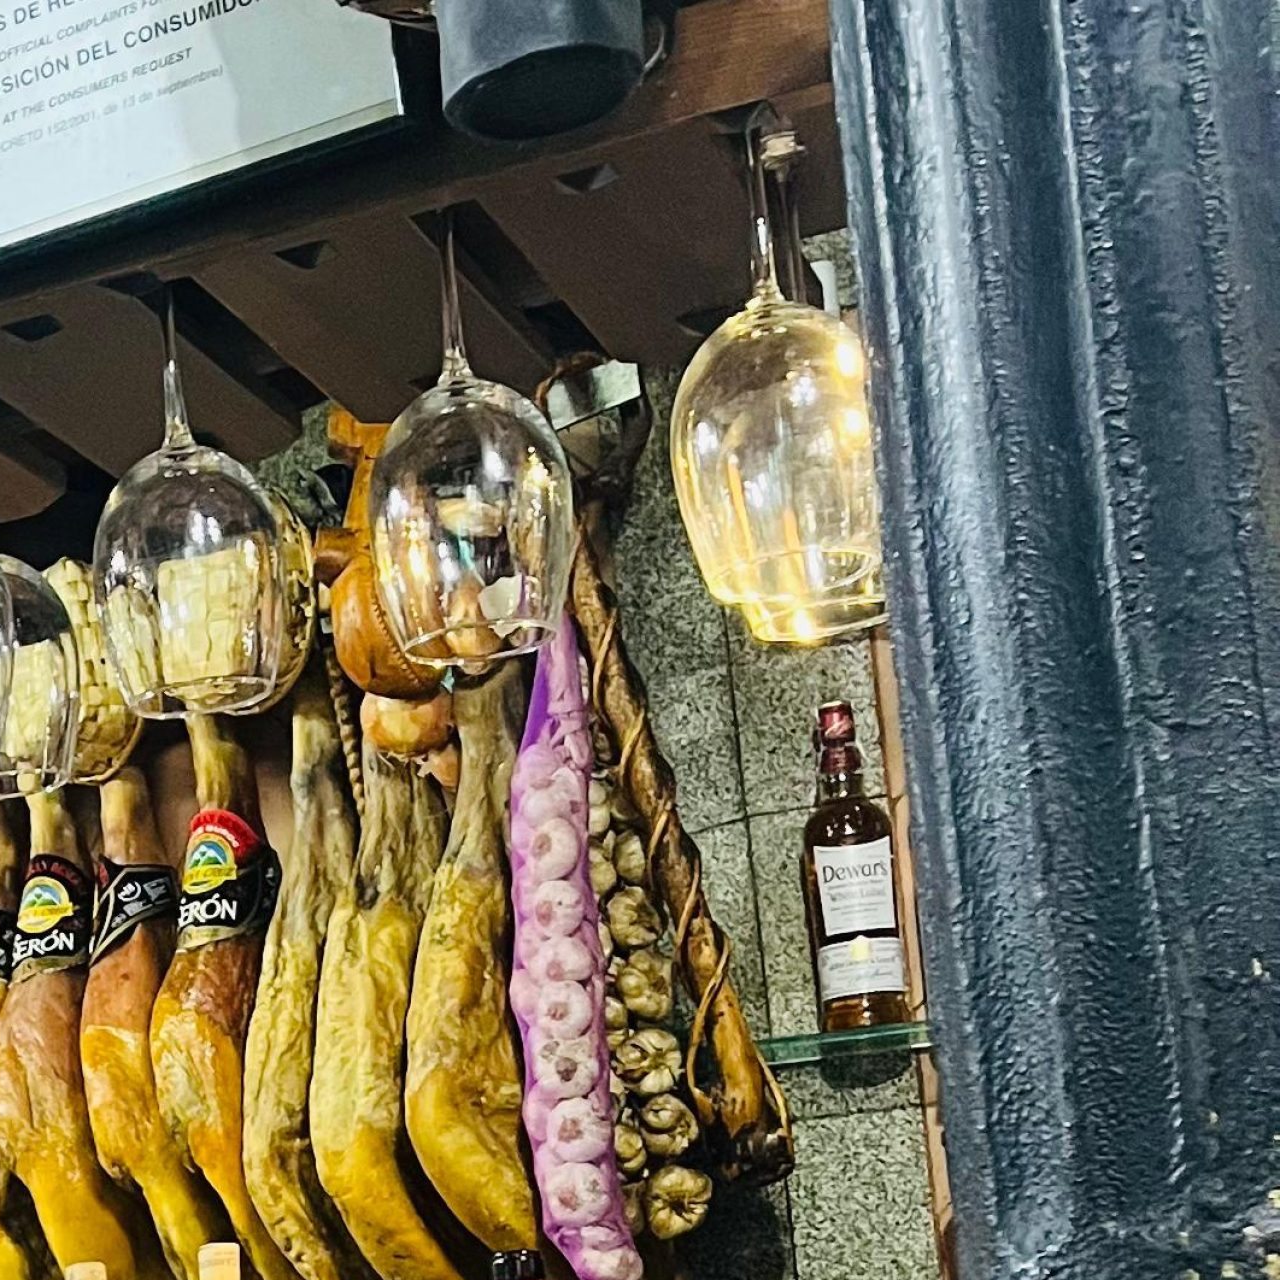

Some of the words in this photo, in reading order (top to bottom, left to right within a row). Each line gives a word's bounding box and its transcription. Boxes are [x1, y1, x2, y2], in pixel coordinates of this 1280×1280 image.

[13, 1, 42, 25] DE
[57, 3, 138, 41] COMPLAINTS
[76, 39, 118, 67] DEL
[123, 0, 259, 49] CONSUMID
[2, 109, 18, 125] AT
[20, 99, 45, 119] THE
[48, 70, 129, 108] CONSUMERS
[131, 46, 193, 78] REQUEST
[178, 892, 238, 928] ERÓN
[12, 928, 75, 968] ERÓN
